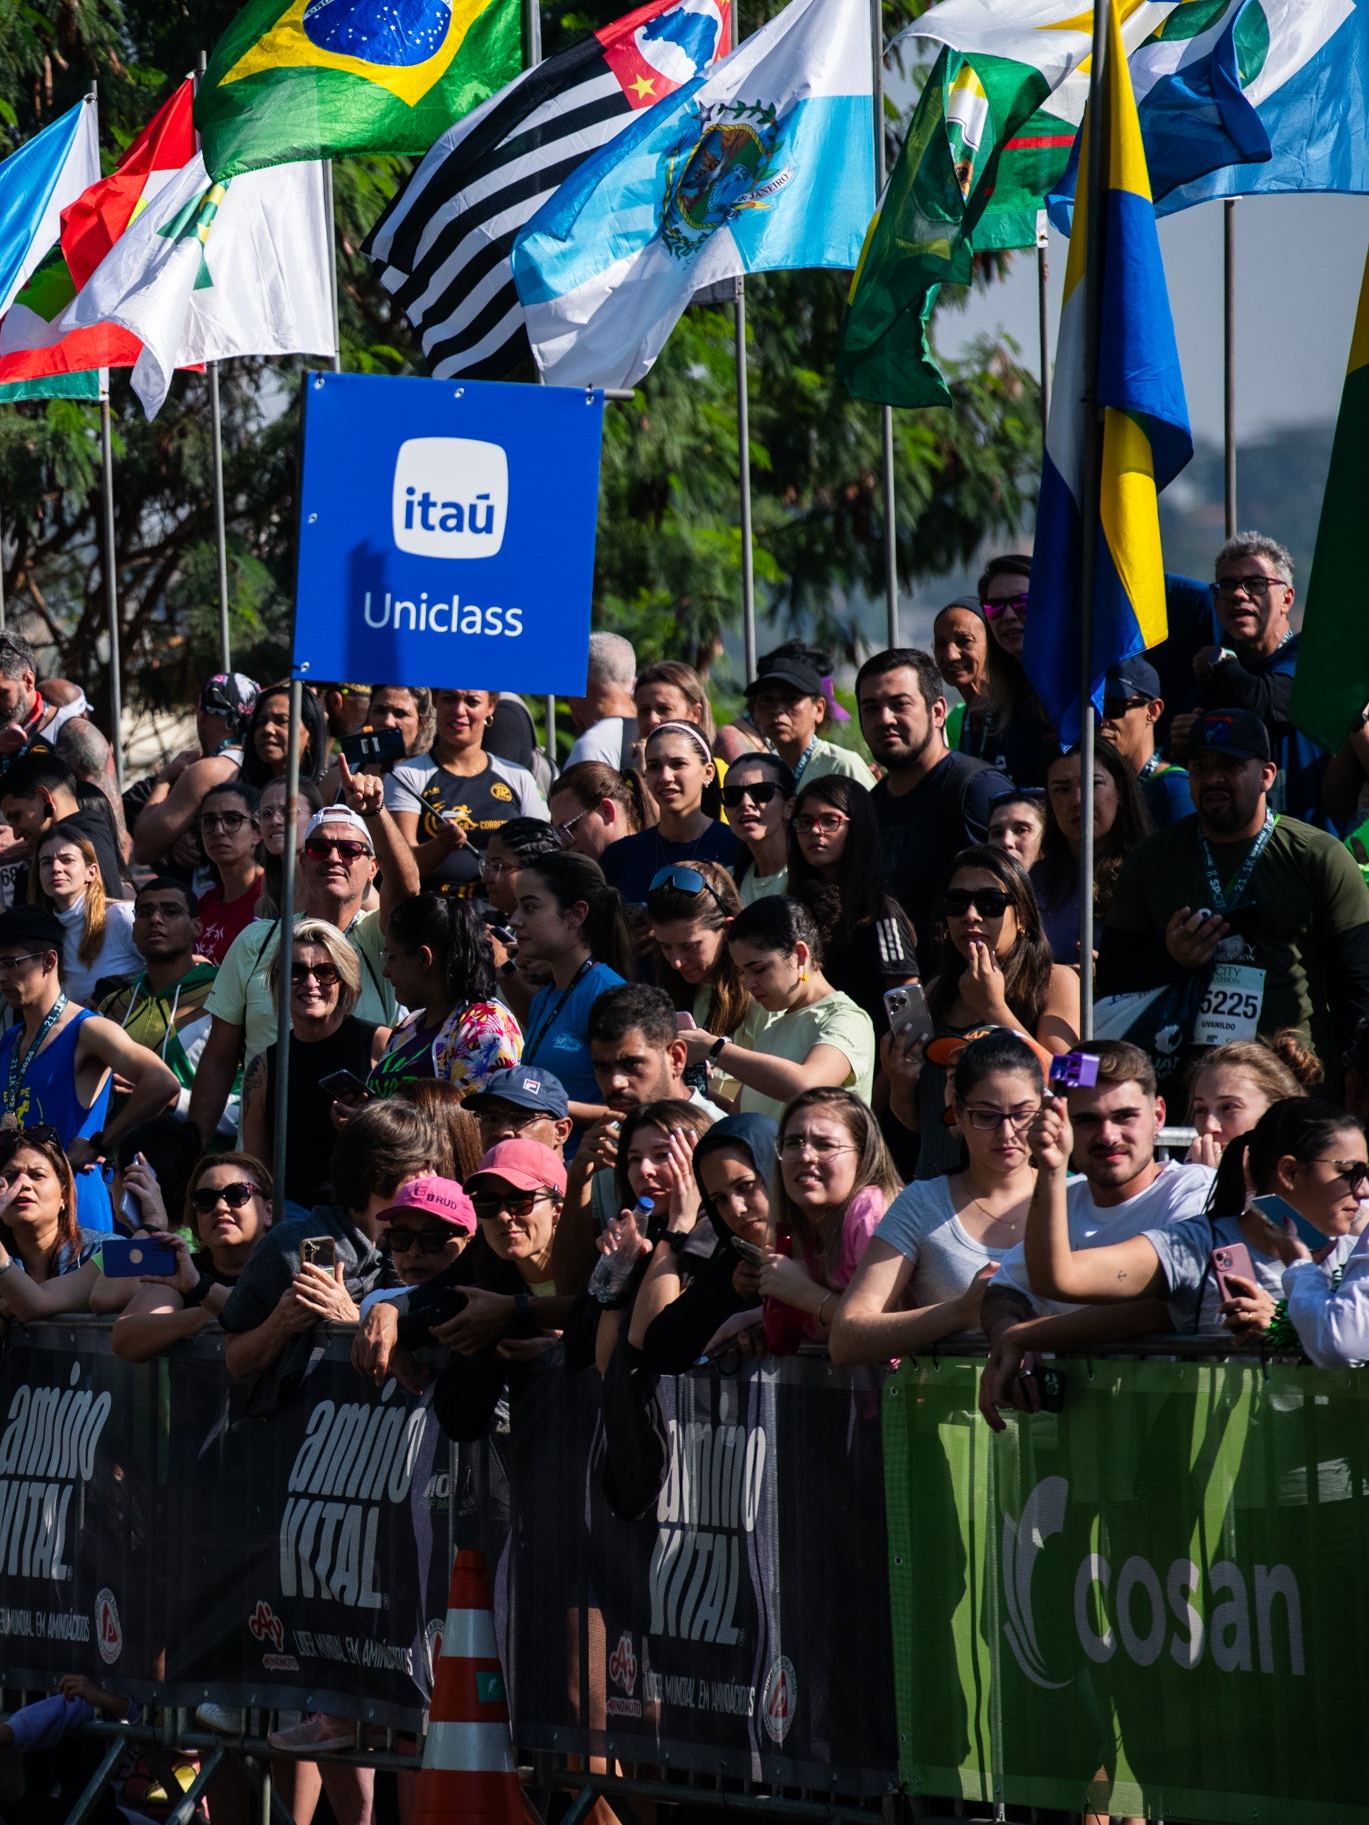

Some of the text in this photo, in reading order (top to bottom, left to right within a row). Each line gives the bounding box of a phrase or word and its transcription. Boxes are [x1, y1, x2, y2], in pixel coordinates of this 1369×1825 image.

[749, 173, 789, 200] JANEIRO
[404, 486, 495, 534] itaú
[364, 591, 523, 637] Uniclass
[1200, 990, 1259, 1020] 5225
[435, 1196, 457, 1210] RUD
[287, 1377, 427, 1504] amino
[657, 1392, 766, 1532] amino
[1074, 1553, 1306, 1677] cosan
